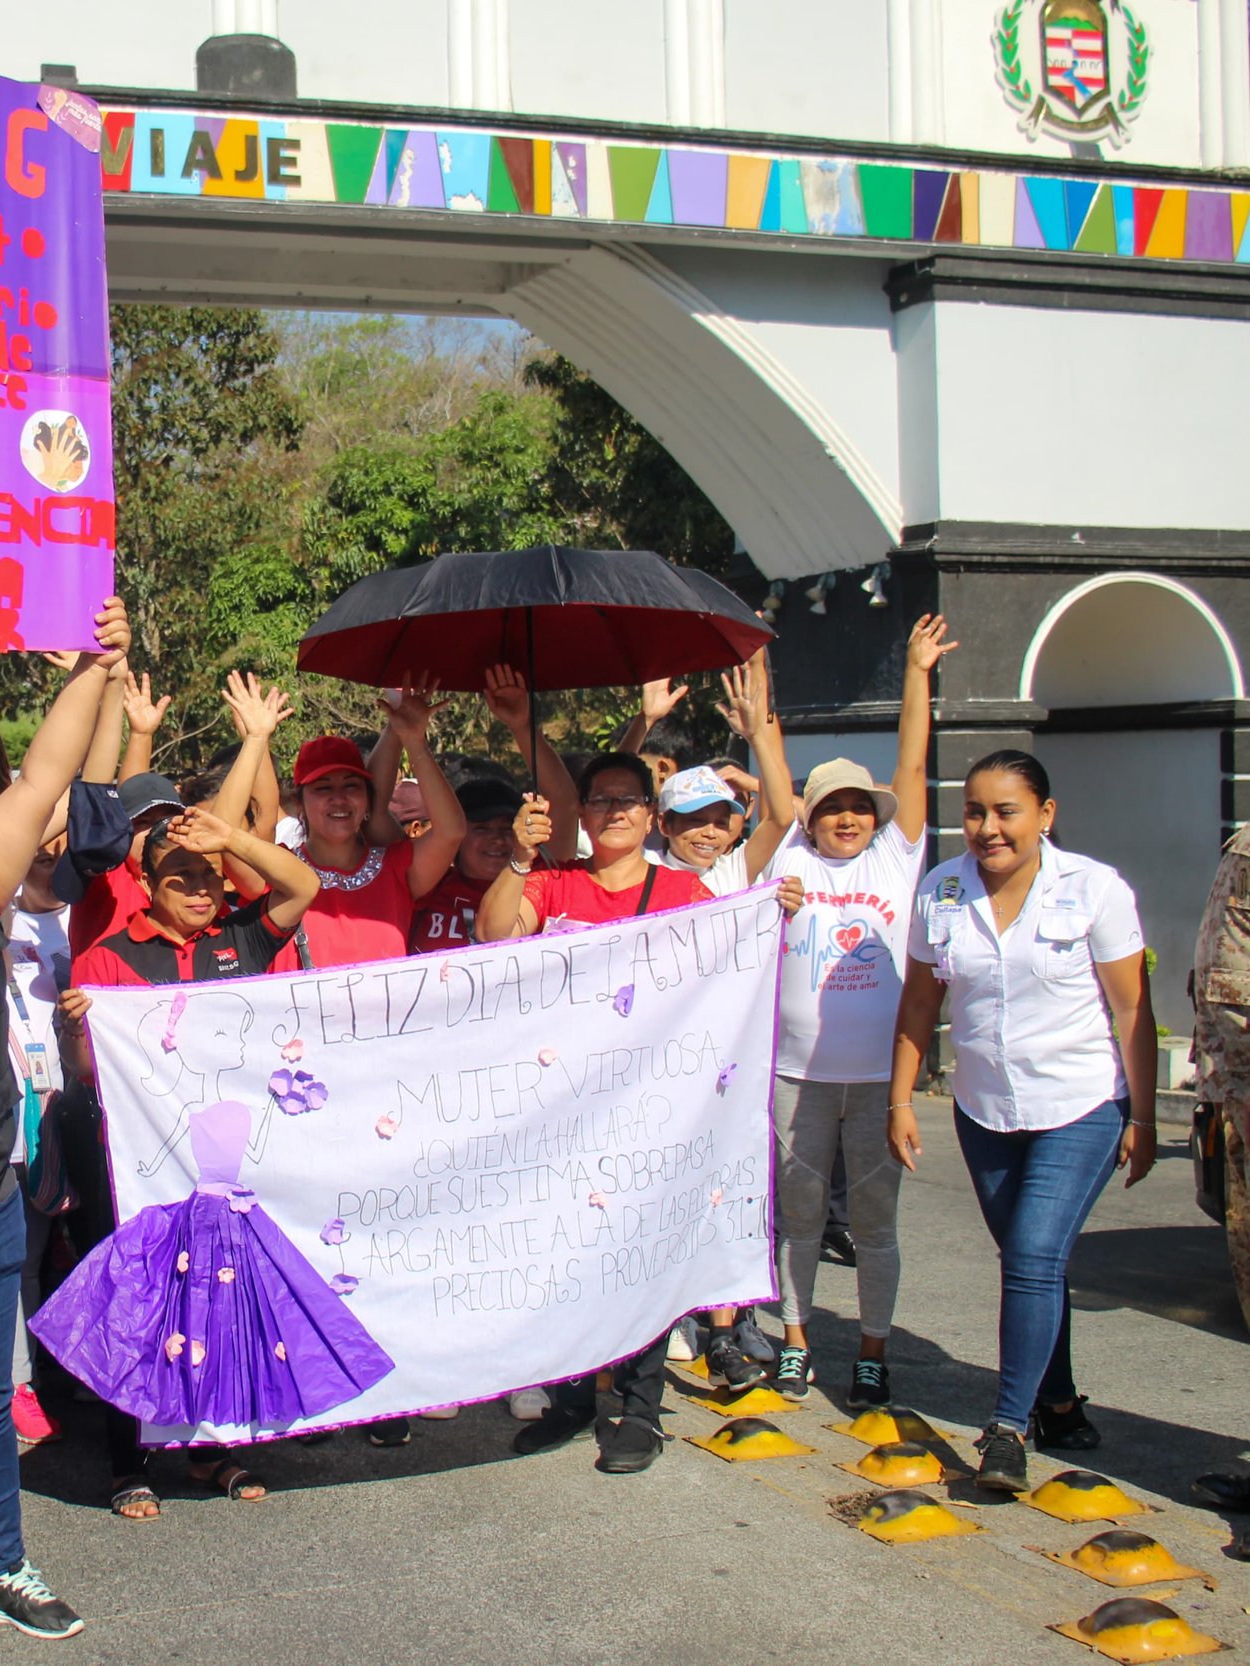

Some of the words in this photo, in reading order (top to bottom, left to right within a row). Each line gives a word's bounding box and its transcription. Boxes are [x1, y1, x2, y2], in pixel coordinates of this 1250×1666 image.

[100, 126, 301, 188] VIAJE
[803, 892, 896, 926] FERMERÍA
[272, 967, 434, 1048] FELIZ
[442, 955, 532, 1028] DIA
[540, 943, 591, 1009] DE
[596, 932, 667, 1002] LA
[668, 897, 782, 987] MUJER
[387, 1061, 546, 1128] MUJER
[557, 1030, 726, 1098] VIRTUOSA
[338, 1179, 443, 1227] PORQUE
[447, 1175, 478, 1214] SU
[480, 1160, 596, 1209] ESTIMA
[598, 1128, 715, 1194] SOBREPASA
[551, 1214, 576, 1252] A
[623, 1202, 655, 1244] DE
[433, 1258, 581, 1317] PRECIOSAS
